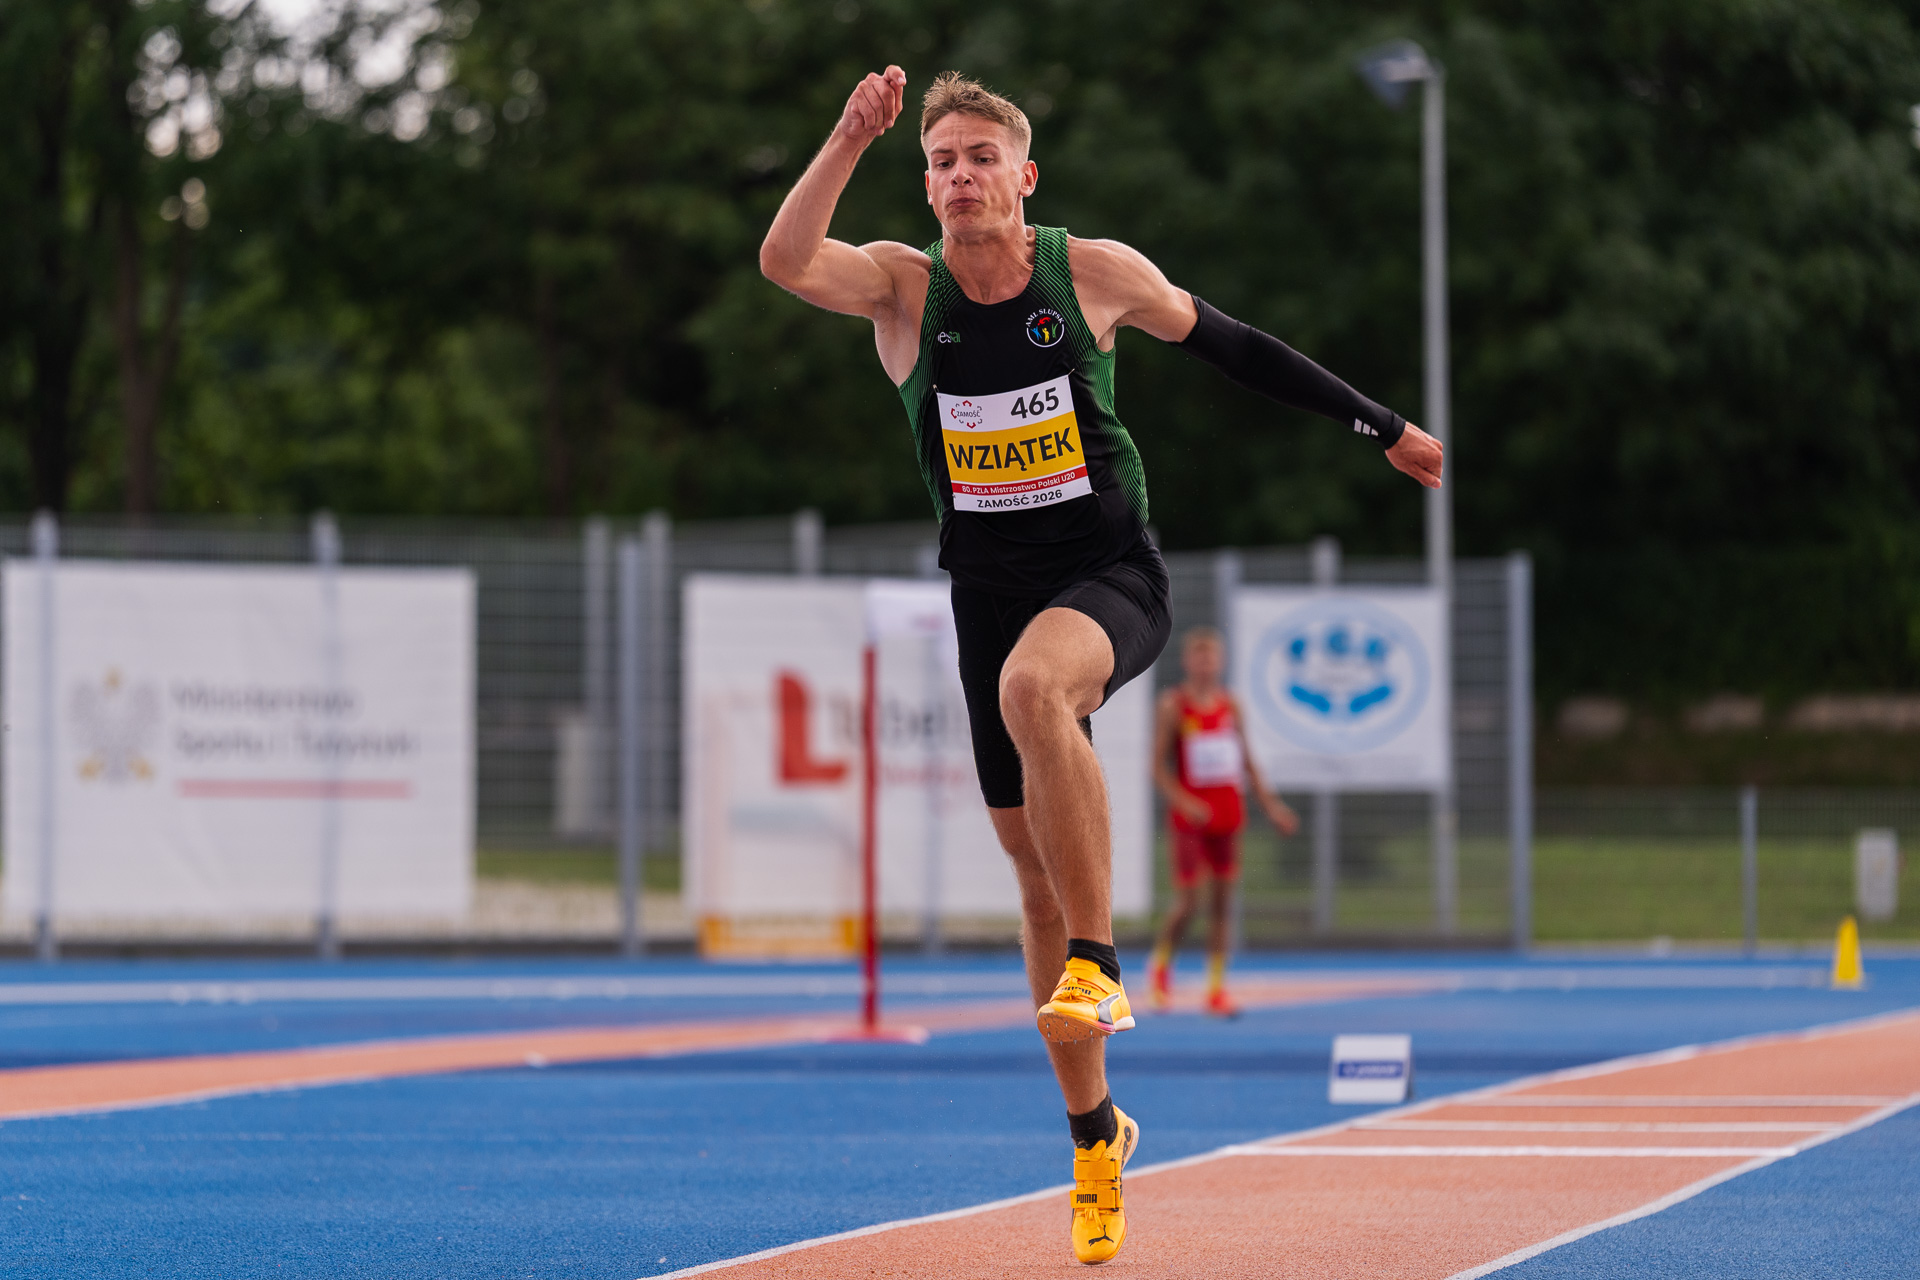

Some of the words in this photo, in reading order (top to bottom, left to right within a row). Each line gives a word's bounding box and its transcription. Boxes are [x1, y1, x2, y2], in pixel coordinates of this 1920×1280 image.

[1010, 386, 1060, 419] 465
[948, 426, 1076, 472] WZIĄTEK
[990, 483, 1037, 494] Mistrzostwa
[1037, 476, 1061, 488] Polski
[1061, 471, 1076, 482] U20
[976, 493, 1030, 508] ZAMOŚĆ
[1032, 489, 1063, 504] 2026
[1076, 1193, 1098, 1204] PUMA
